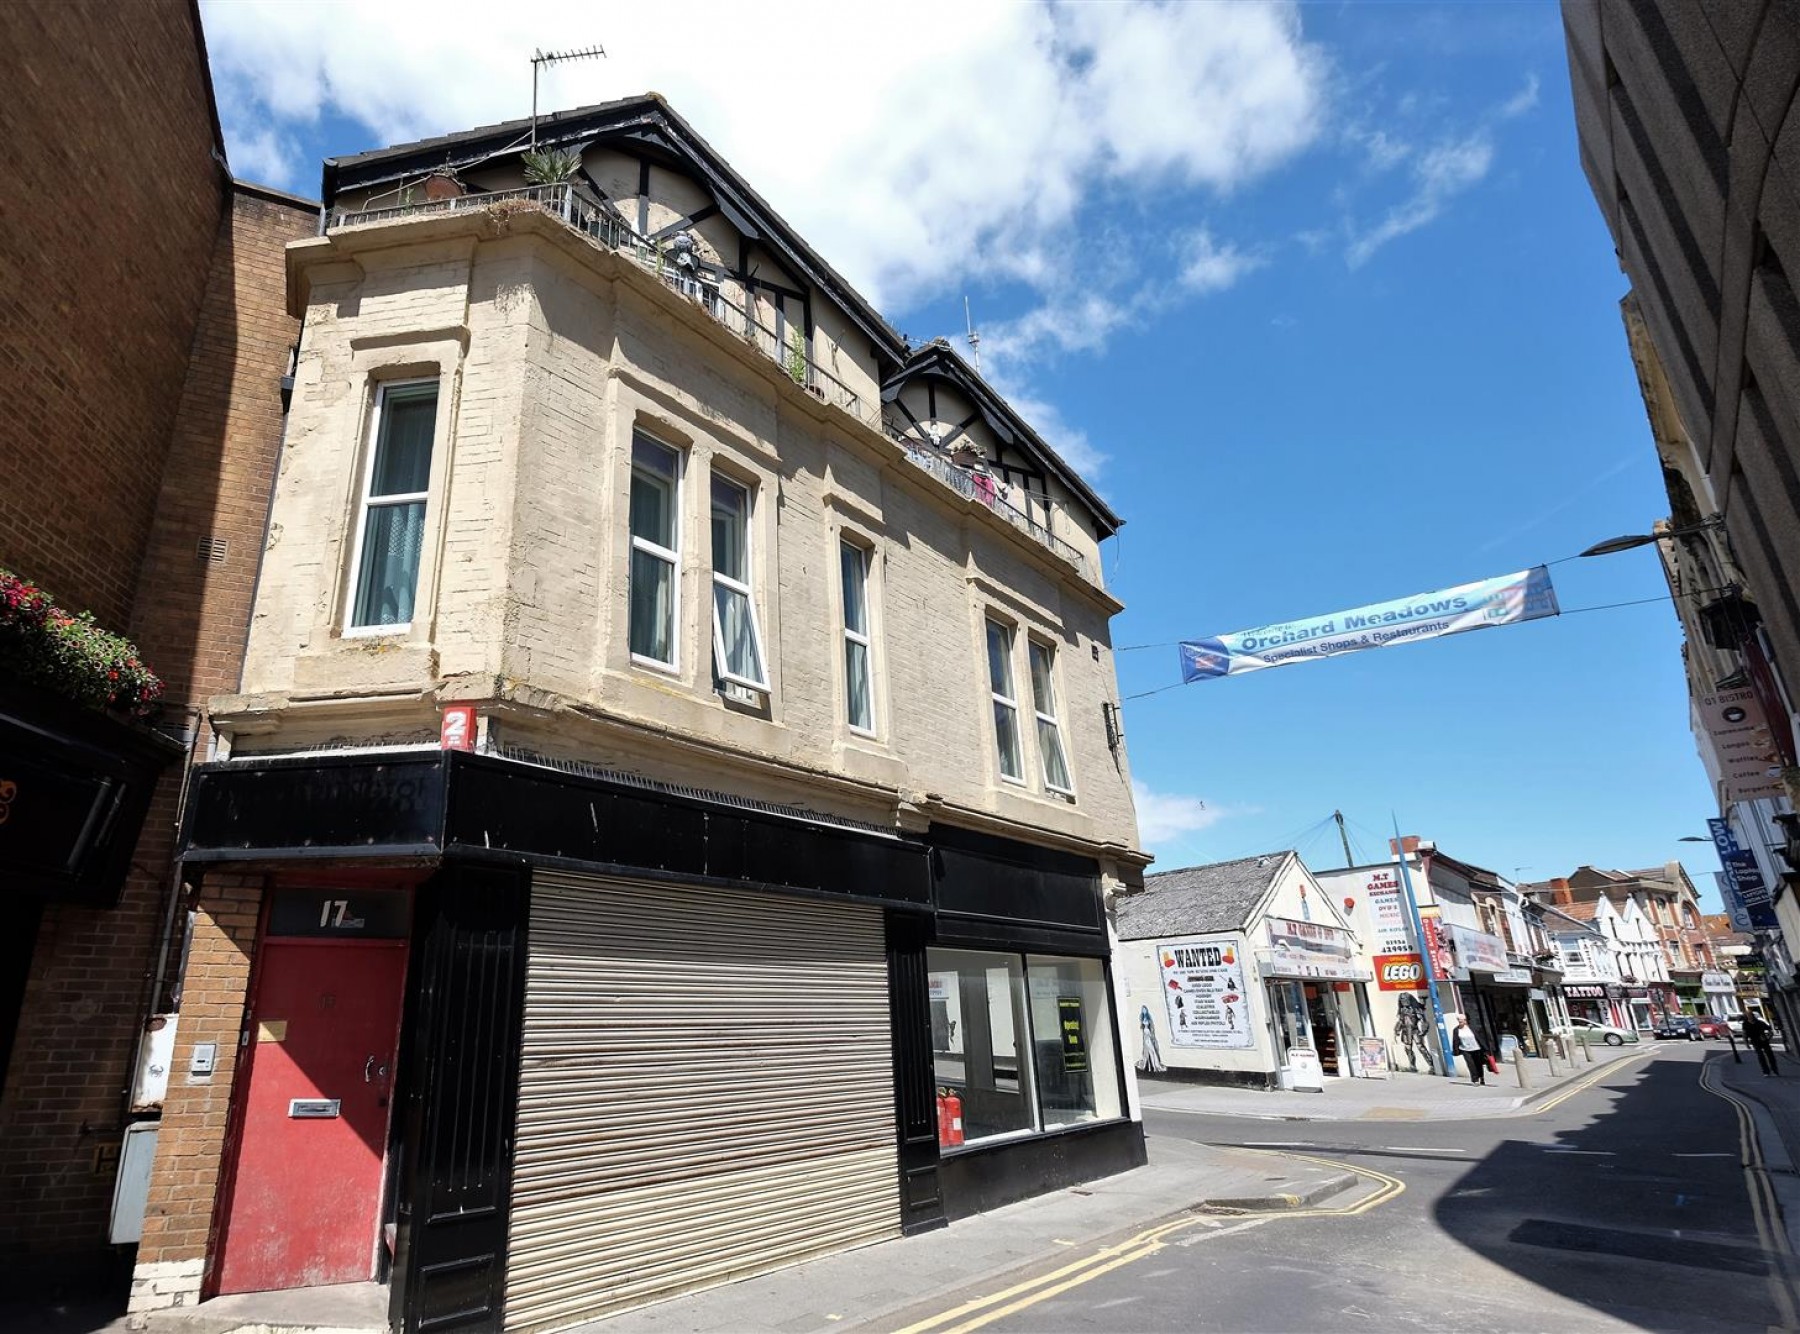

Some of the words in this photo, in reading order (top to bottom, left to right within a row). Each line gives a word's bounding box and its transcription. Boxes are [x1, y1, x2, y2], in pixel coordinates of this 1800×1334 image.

[1241, 619, 1335, 651] Orchard
[1344, 596, 1467, 630] Meadows
[1263, 645, 1318, 663] Specialist
[1320, 636, 1358, 653] Shops
[1360, 635, 1370, 645] &
[1372, 620, 1450, 642] Restaurants
[1719, 690, 1754, 704] BISTRO
[445, 711, 467, 736] 2
[1367, 880, 1399, 891] GAMES
[319, 899, 349, 928] 17
[1175, 947, 1221, 968] WANTED
[1383, 964, 1421, 981] LEGO
[1563, 986, 1604, 998] TATTOO
